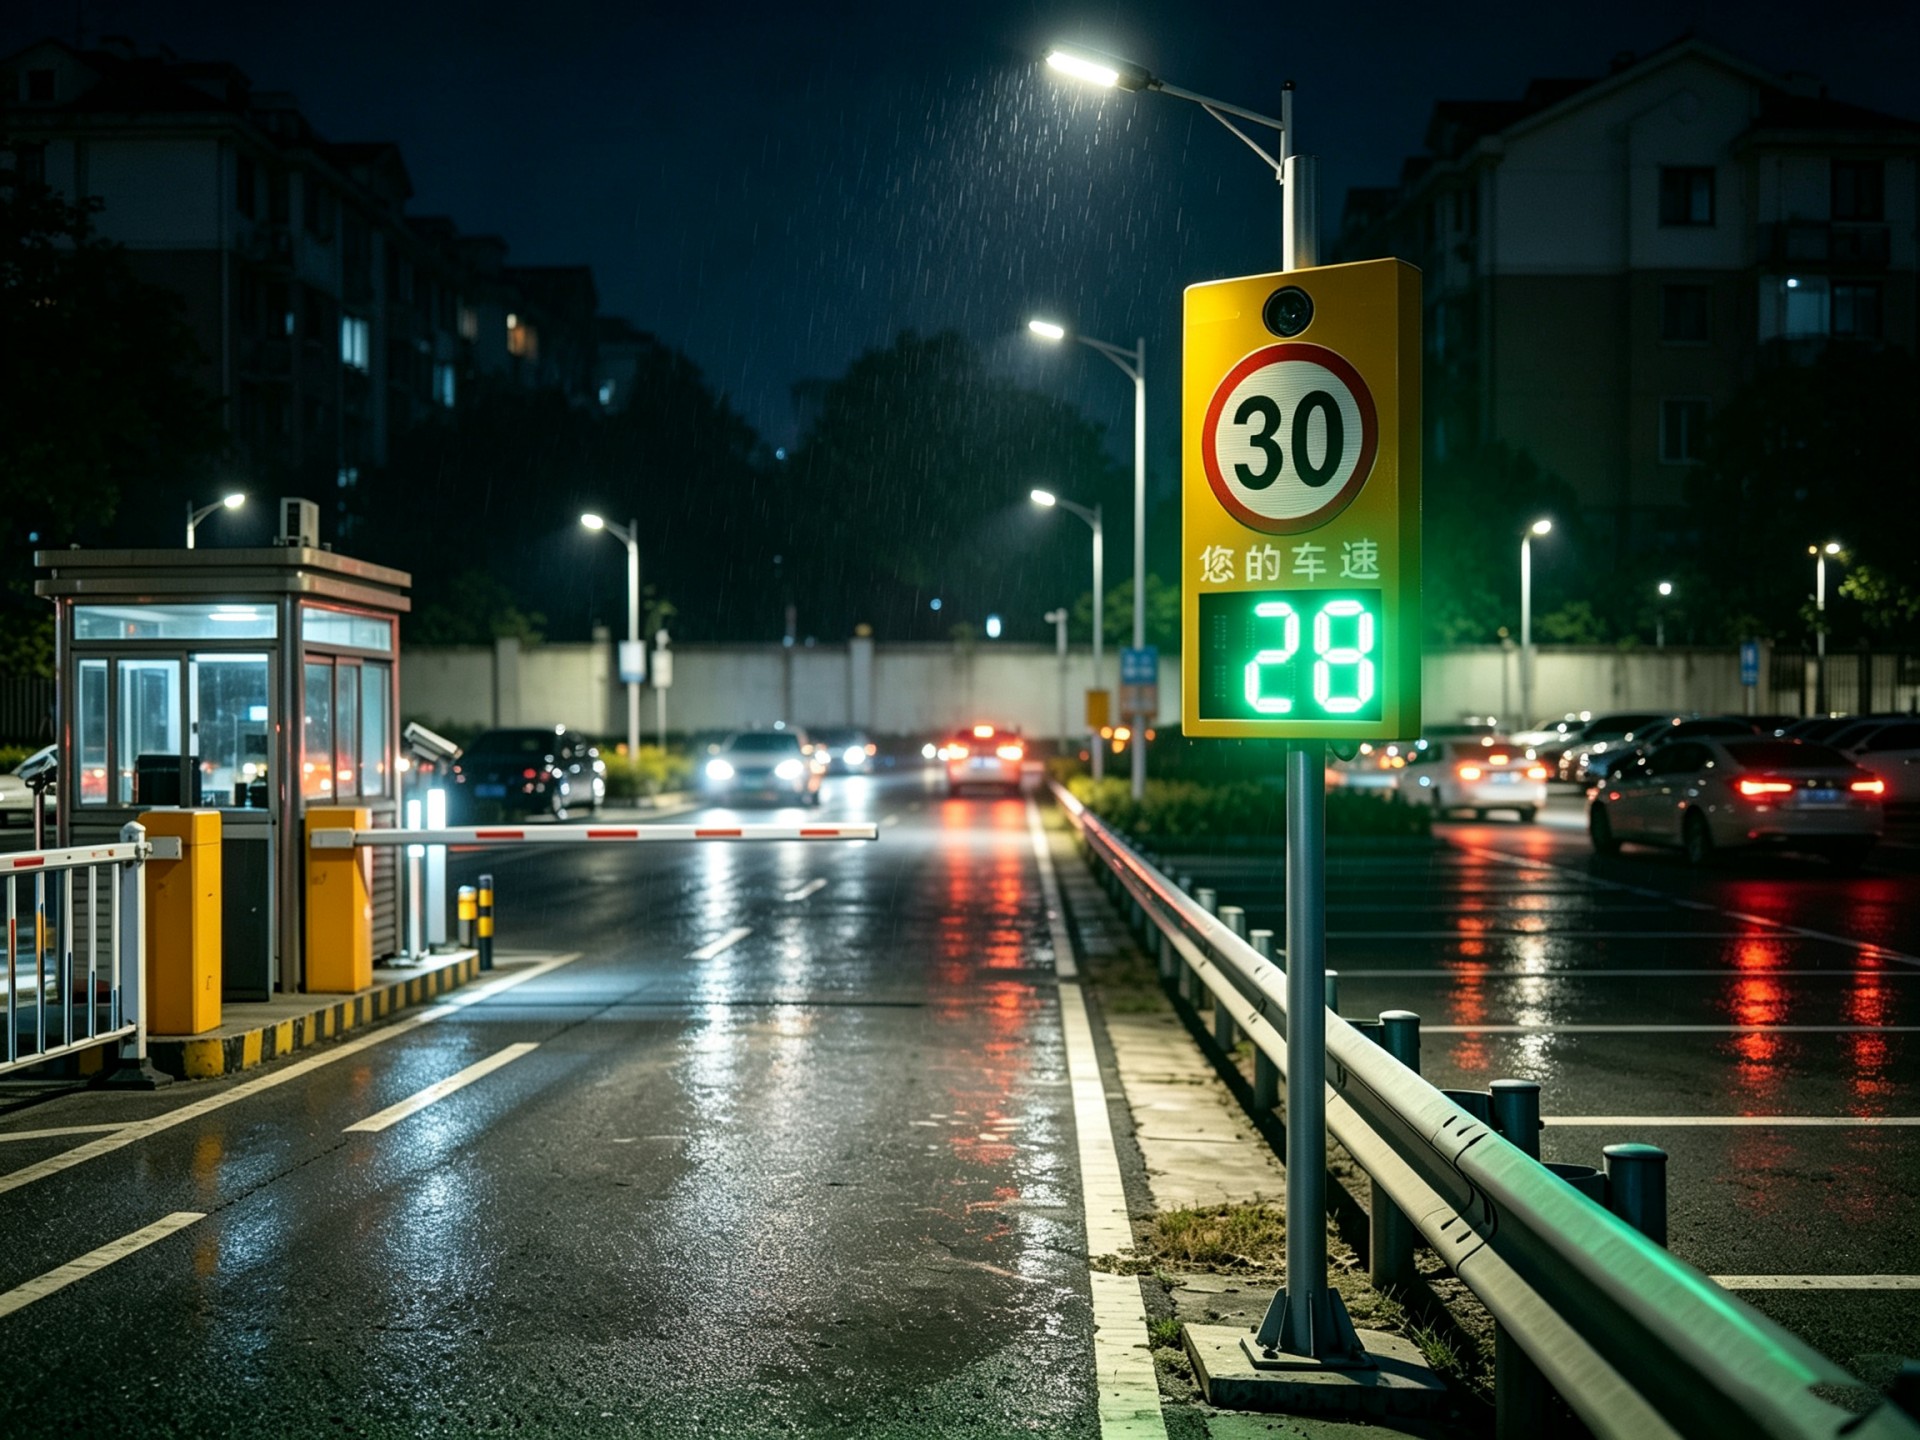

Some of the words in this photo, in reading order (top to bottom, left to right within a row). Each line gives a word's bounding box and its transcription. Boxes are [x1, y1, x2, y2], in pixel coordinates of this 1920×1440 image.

[1233, 390, 1344, 490] 30
[1199, 538, 1380, 584] 您的车速
[1244, 600, 1374, 713] 28
